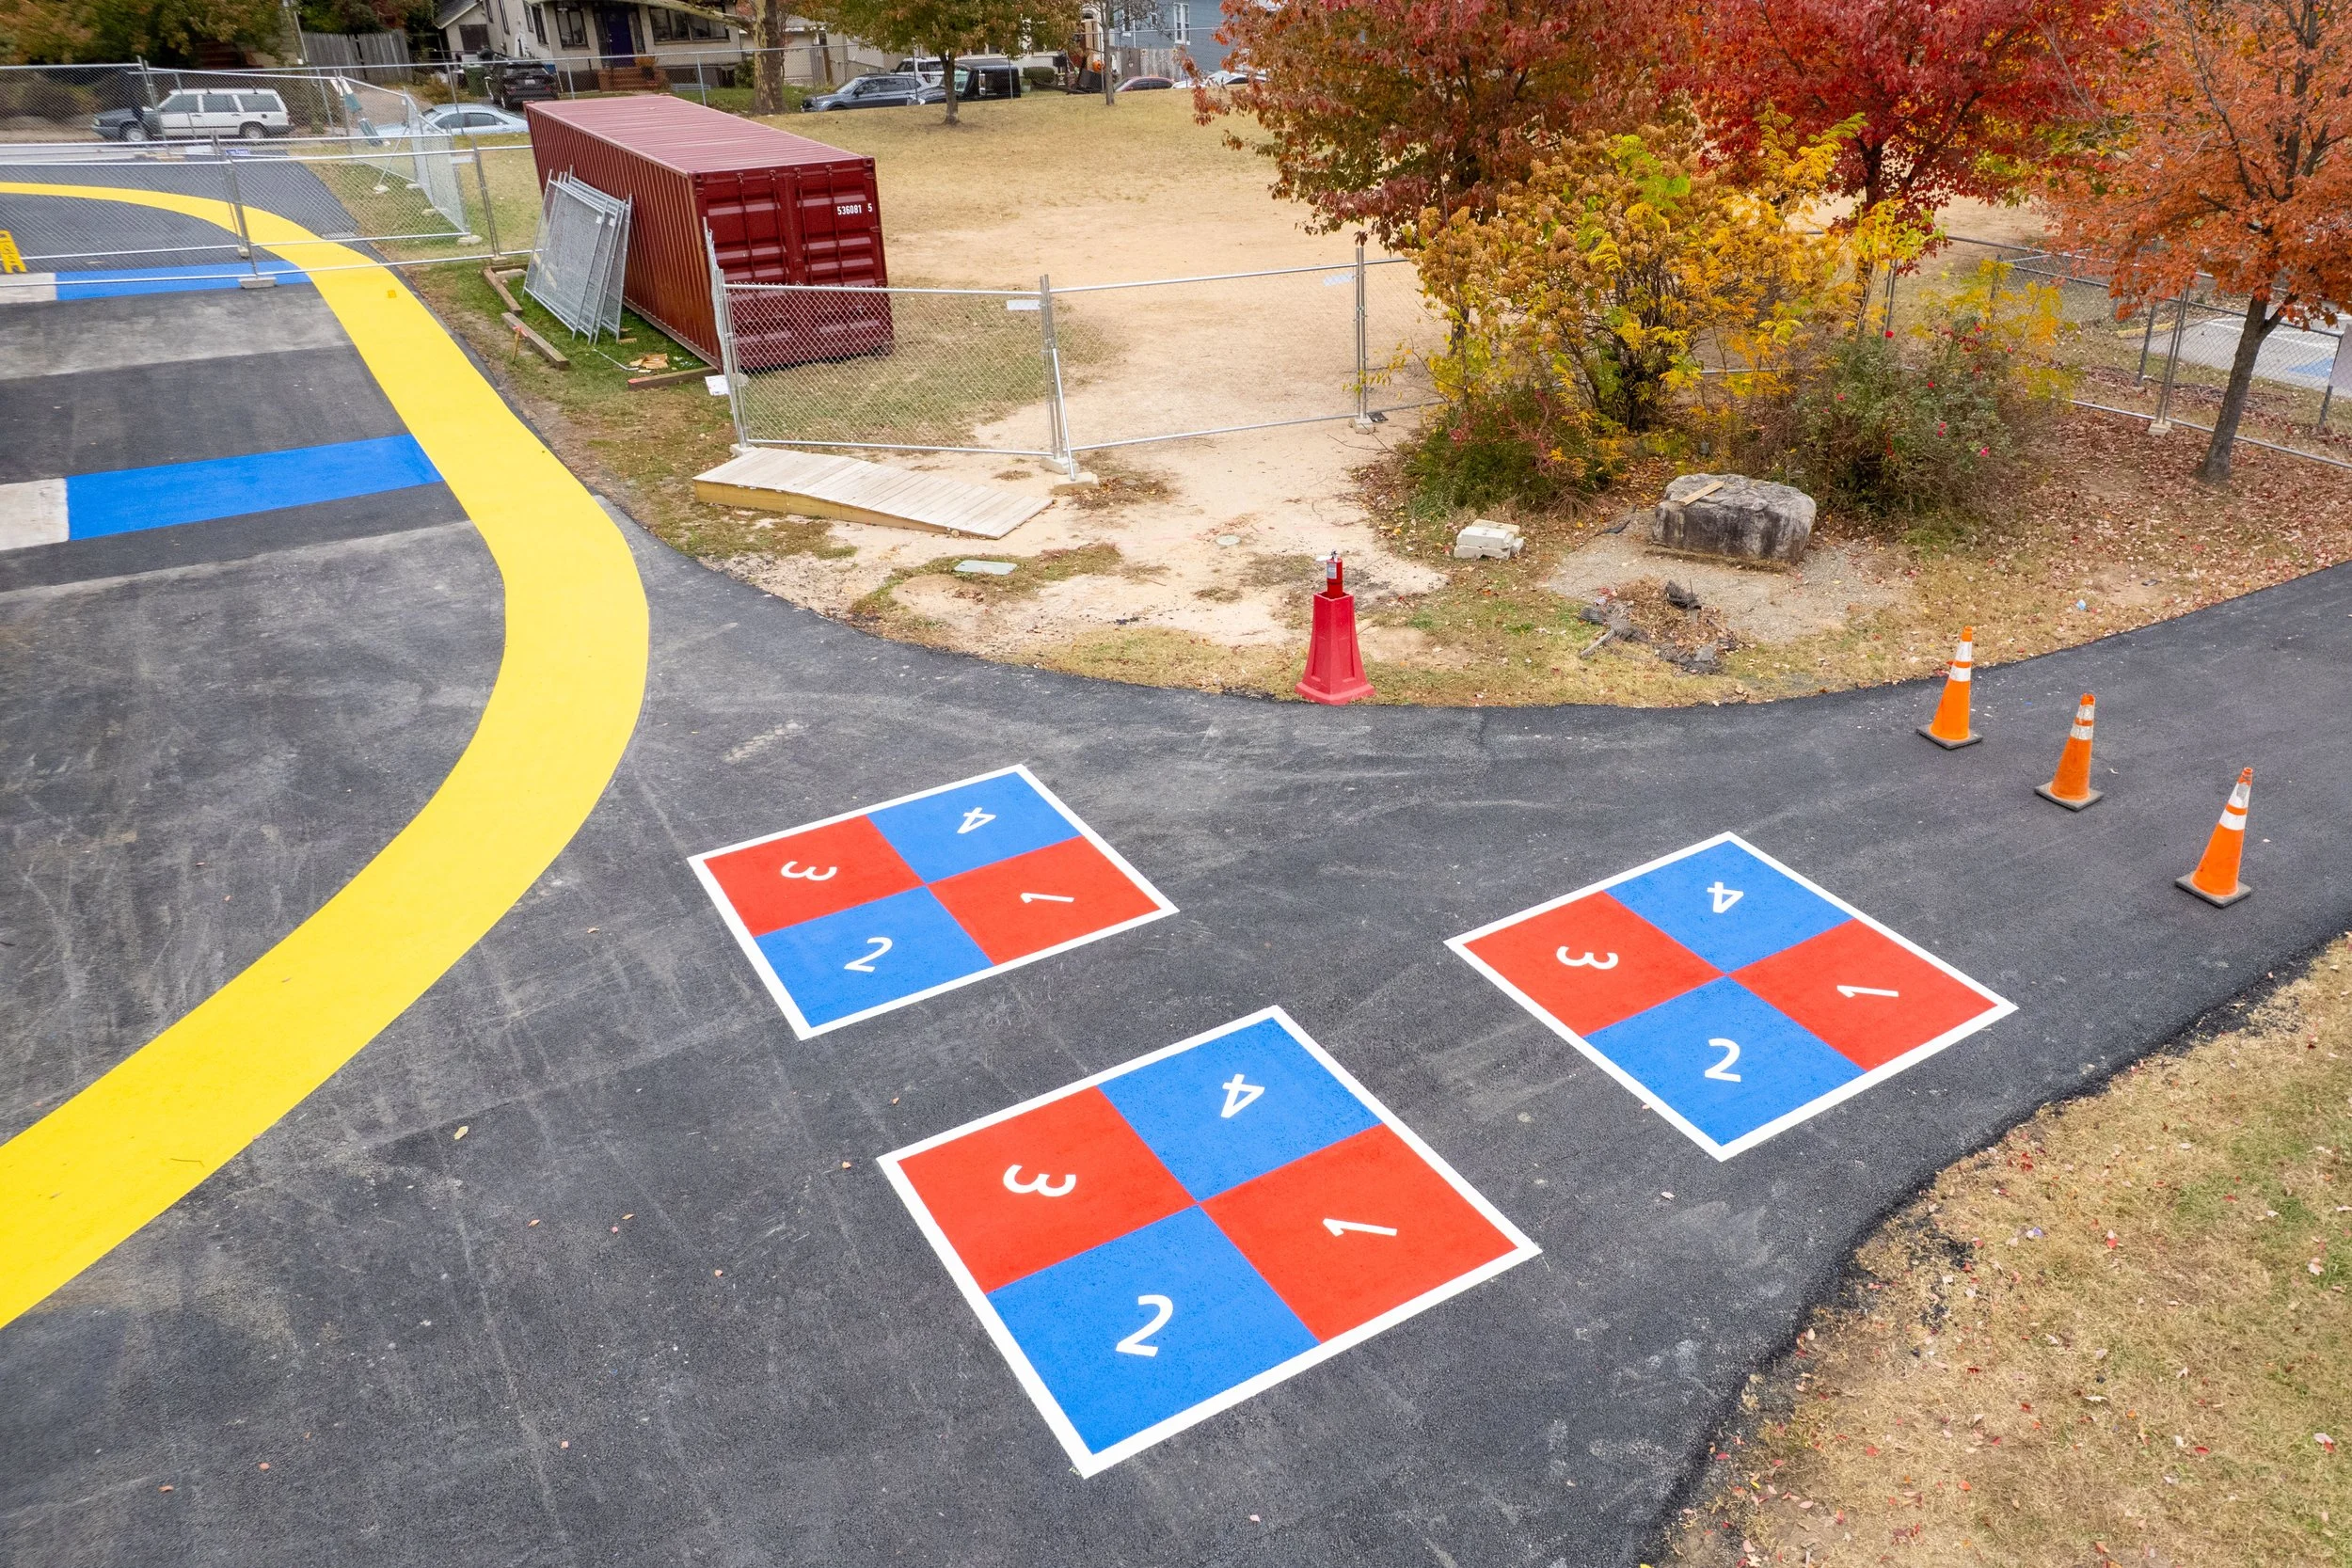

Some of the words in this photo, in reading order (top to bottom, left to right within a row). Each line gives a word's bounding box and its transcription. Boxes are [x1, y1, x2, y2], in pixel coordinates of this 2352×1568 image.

[867, 202, 873, 213] 5
[957, 807, 996, 833] 4
[781, 862, 837, 881] 3
[1020, 892, 1074, 903] 1
[1707, 881, 1743, 913] 4
[844, 937, 893, 972] 2
[1555, 945, 1619, 970] 3
[1837, 984, 1899, 998] 1
[1705, 1038, 1740, 1082] 2
[1221, 1074, 1264, 1118] 4
[1003, 1164, 1076, 1197] 3
[1323, 1218, 1397, 1236] 1
[1116, 1294, 1173, 1356] 2
